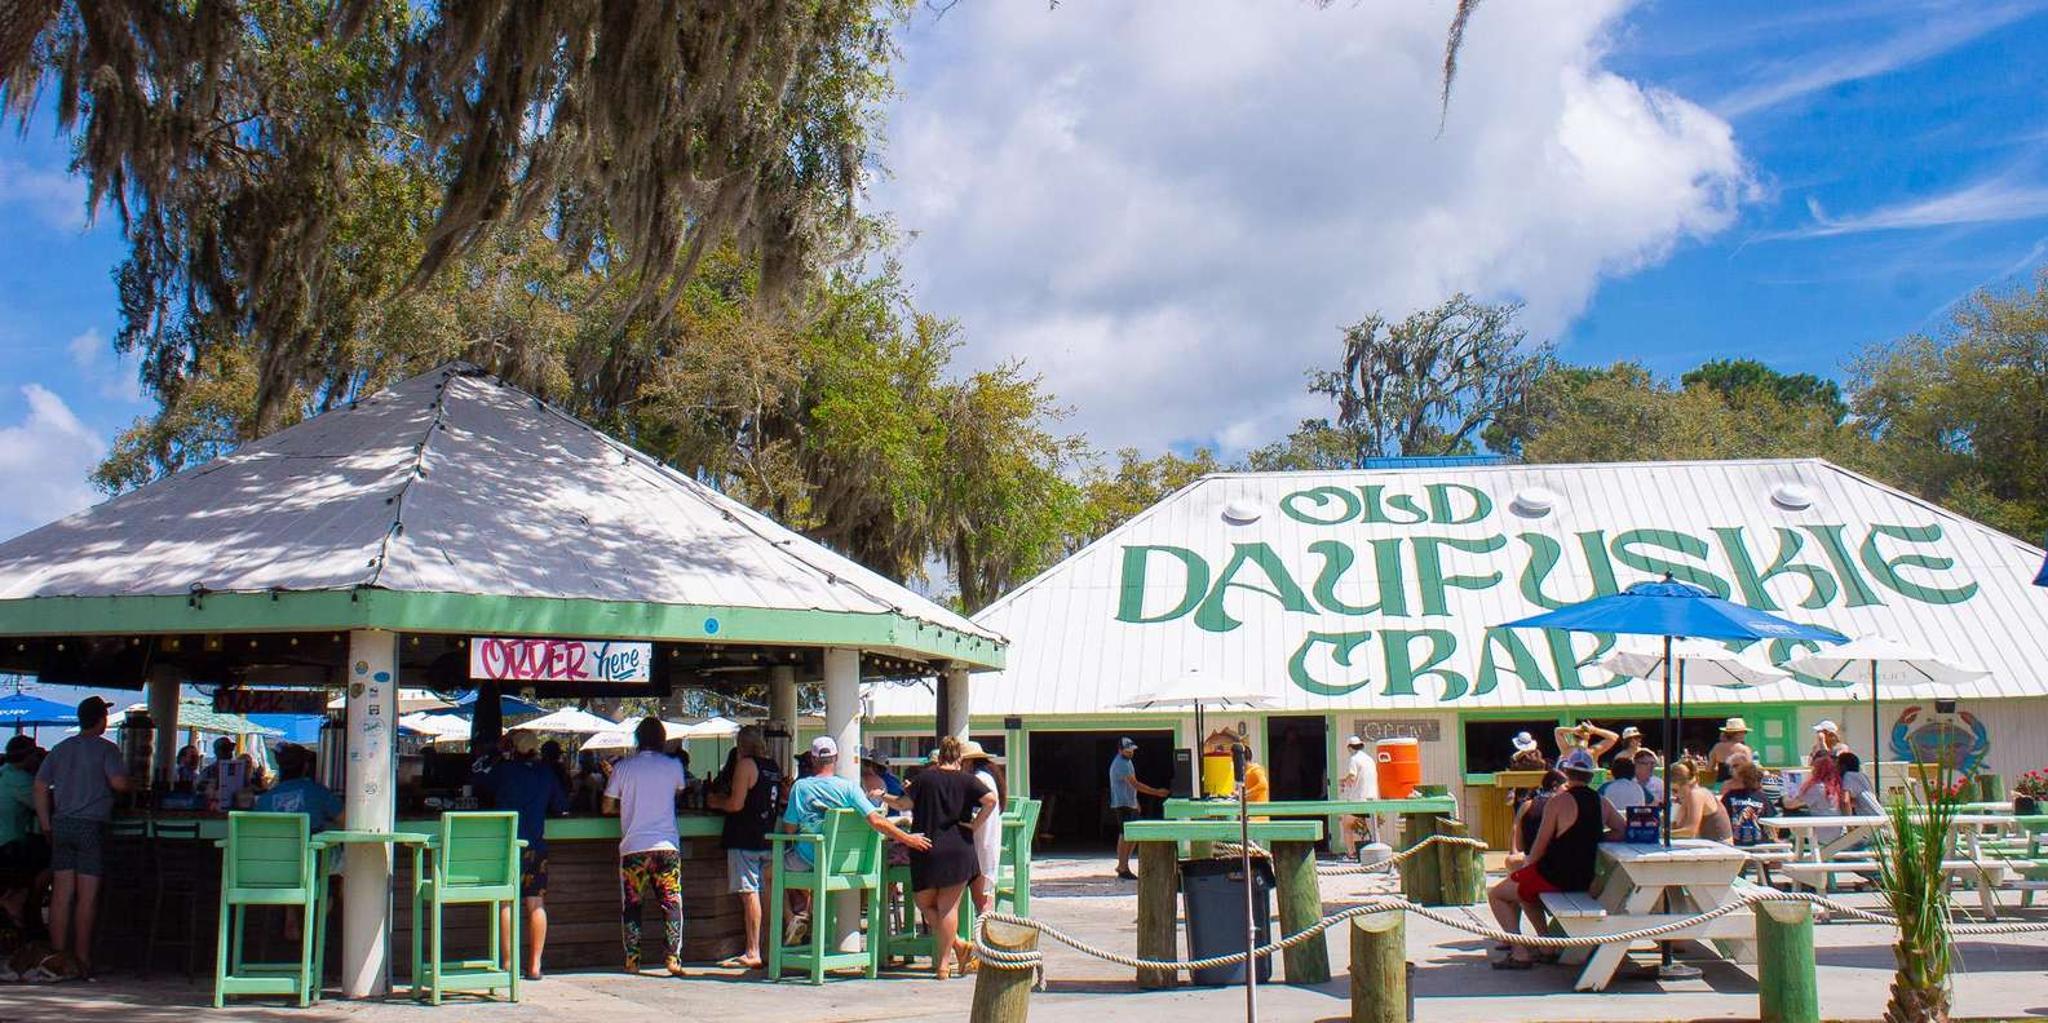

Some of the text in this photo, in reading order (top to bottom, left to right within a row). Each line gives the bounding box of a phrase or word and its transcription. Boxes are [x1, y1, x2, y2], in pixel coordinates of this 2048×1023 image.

[1279, 483, 1493, 526] OLD
[1114, 523, 1979, 632] DAUFUSKIE
[481, 638, 640, 681] ORDER here
[1288, 628, 1633, 701] CRAB
